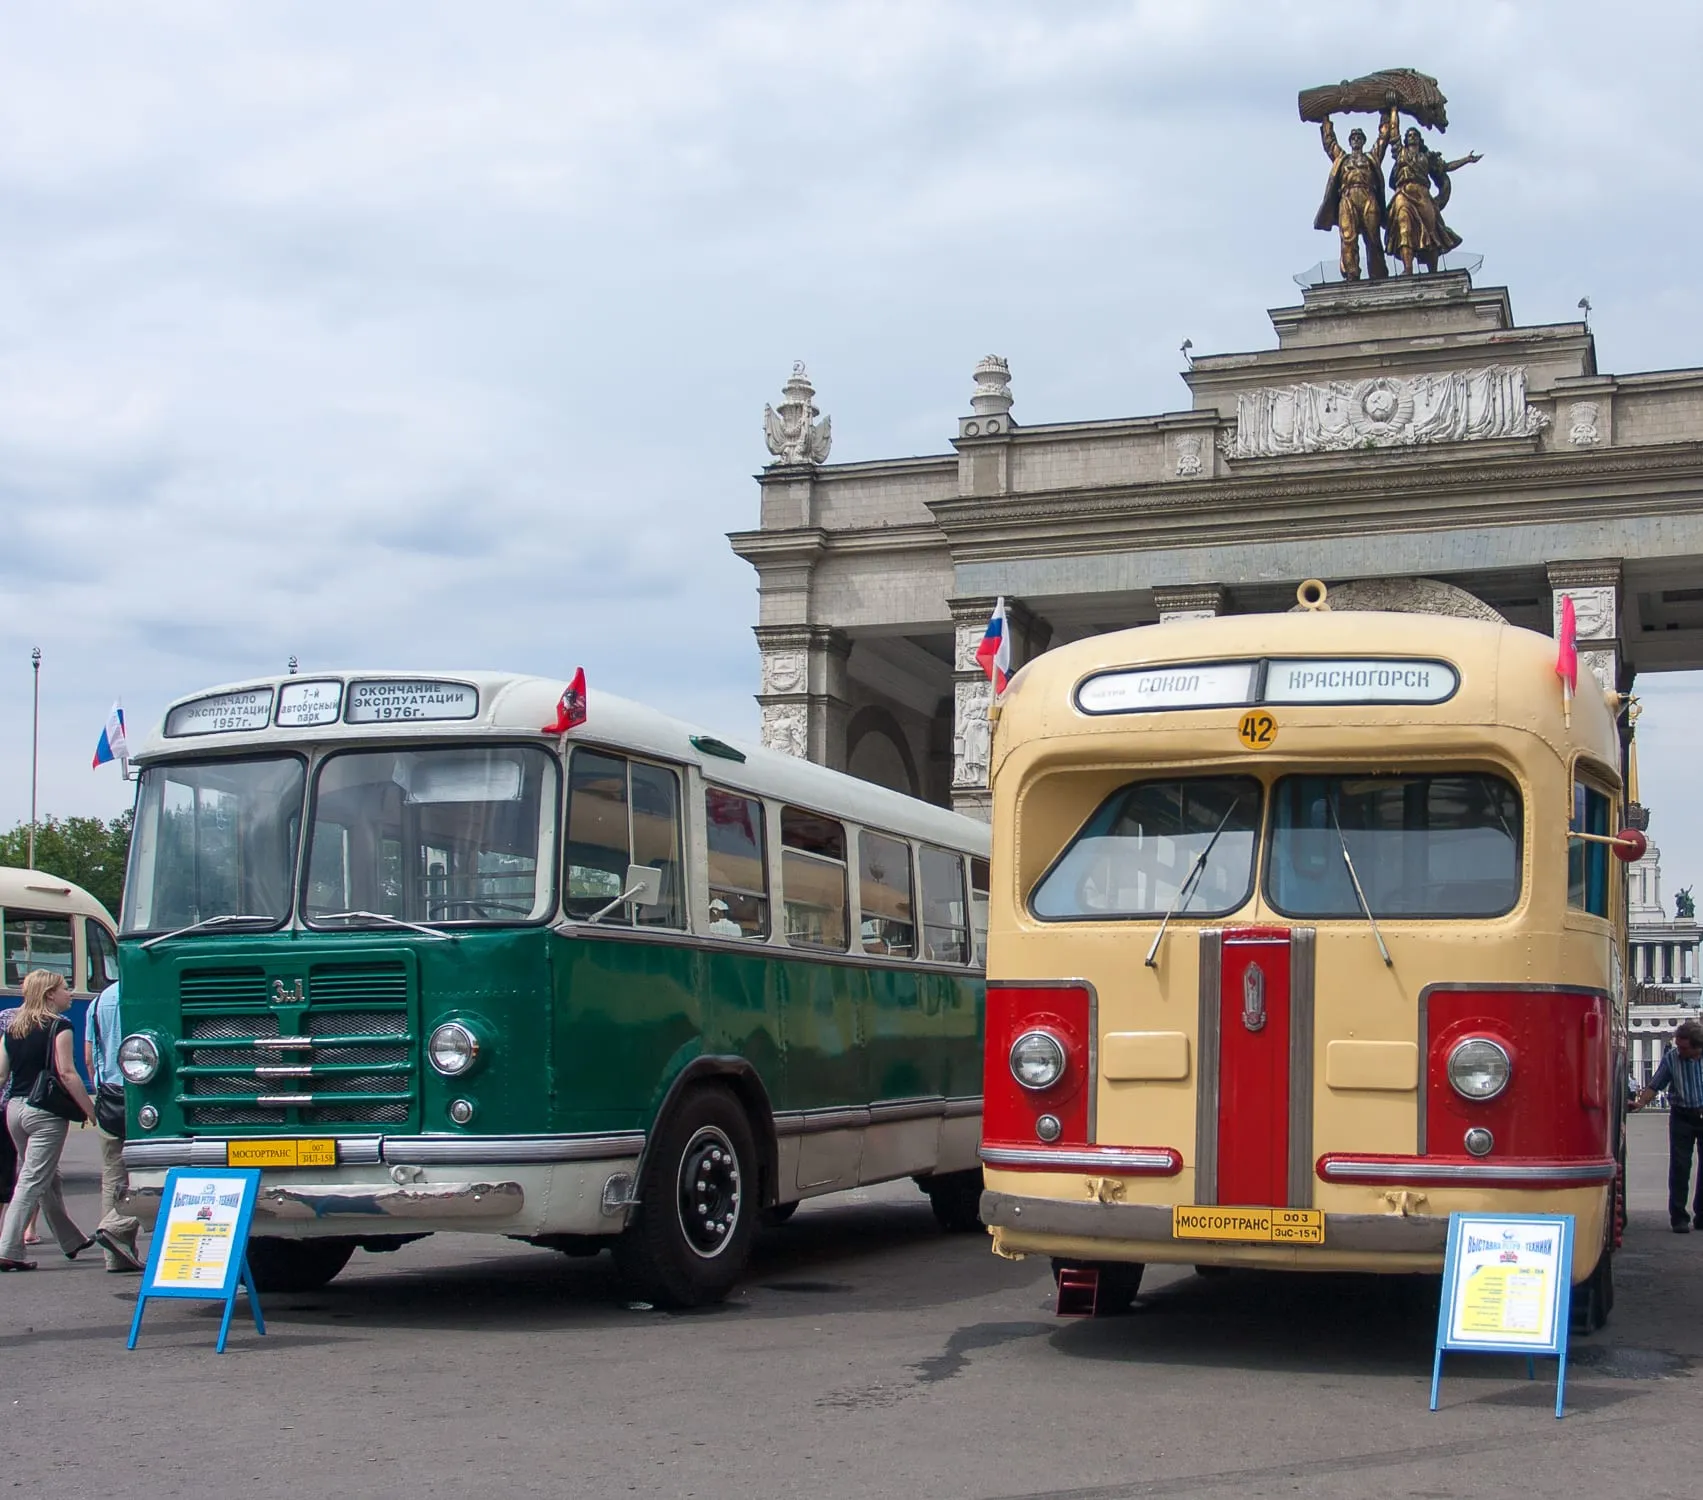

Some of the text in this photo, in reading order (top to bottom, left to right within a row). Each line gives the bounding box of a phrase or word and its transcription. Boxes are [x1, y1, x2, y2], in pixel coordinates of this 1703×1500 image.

[1288, 669, 1430, 690] КРАСНОГОРСК
[360, 684, 441, 697] ОКОНЧАНИЕ
[213, 695, 256, 707] НАЧАЛО
[281, 700, 338, 714] автобусный
[354, 694, 464, 708] ЭКСПЛУАТАЦИИ
[188, 705, 271, 718] ЭКСПЛУАТАЦИИ
[374, 707, 425, 719] 1976г.
[212, 717, 252, 729] 1957г.
[297, 712, 320, 725] парк
[1241, 717, 1271, 743] 42
[232, 1149, 291, 1158] МОСГОРТРАНС
[311, 1144, 324, 1152] 007
[1181, 1215, 1269, 1231] МОСГОРТРАНС
[1284, 1213, 1308, 1222] 003
